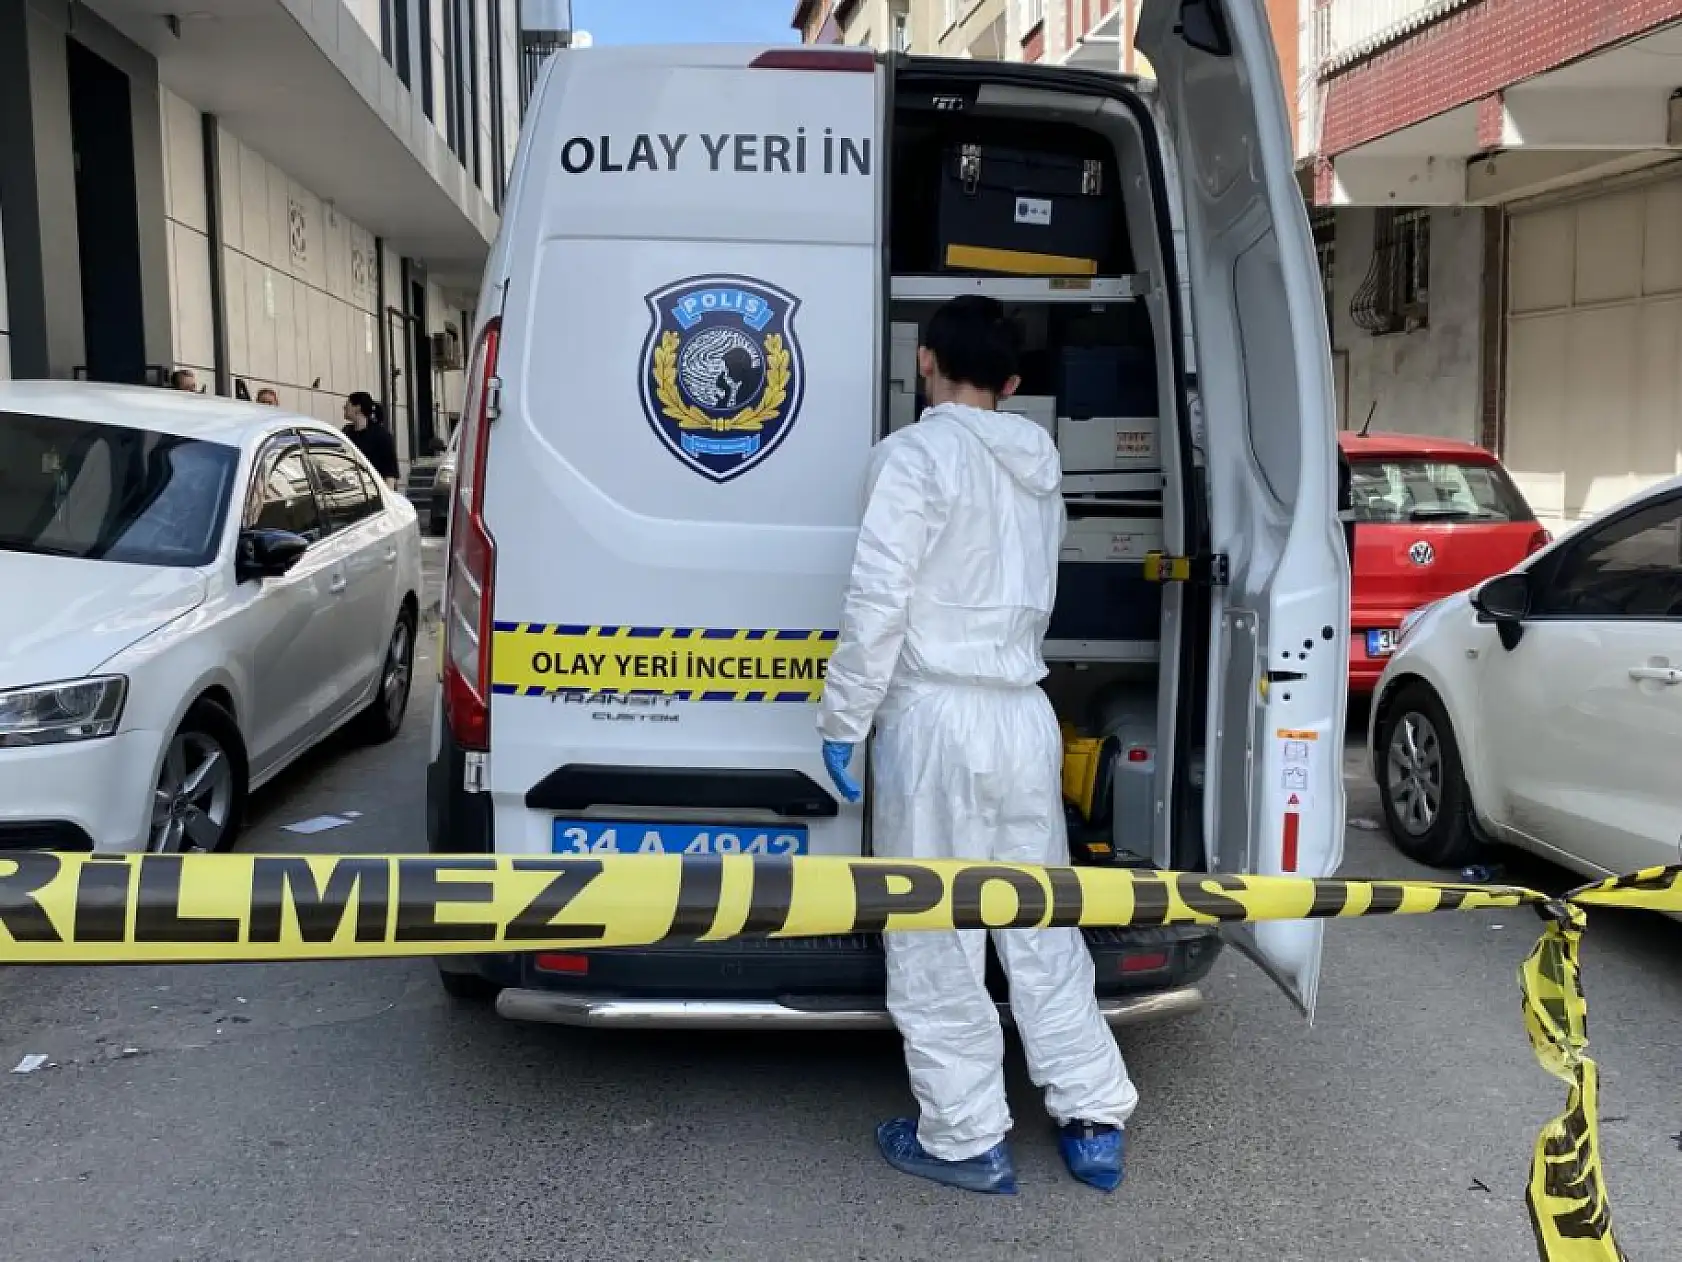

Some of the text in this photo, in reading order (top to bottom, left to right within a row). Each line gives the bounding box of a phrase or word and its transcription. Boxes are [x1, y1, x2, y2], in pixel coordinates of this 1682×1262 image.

[561, 126, 871, 176] OLAY YERİ İN
[683, 291, 760, 313] POLİS
[532, 650, 828, 680] OLAY YERİ İNCELEME
[592, 711, 679, 722] CUSTOM
[563, 827, 619, 856] 34
[637, 831, 666, 855] A
[848, 863, 1248, 934] POLİS
